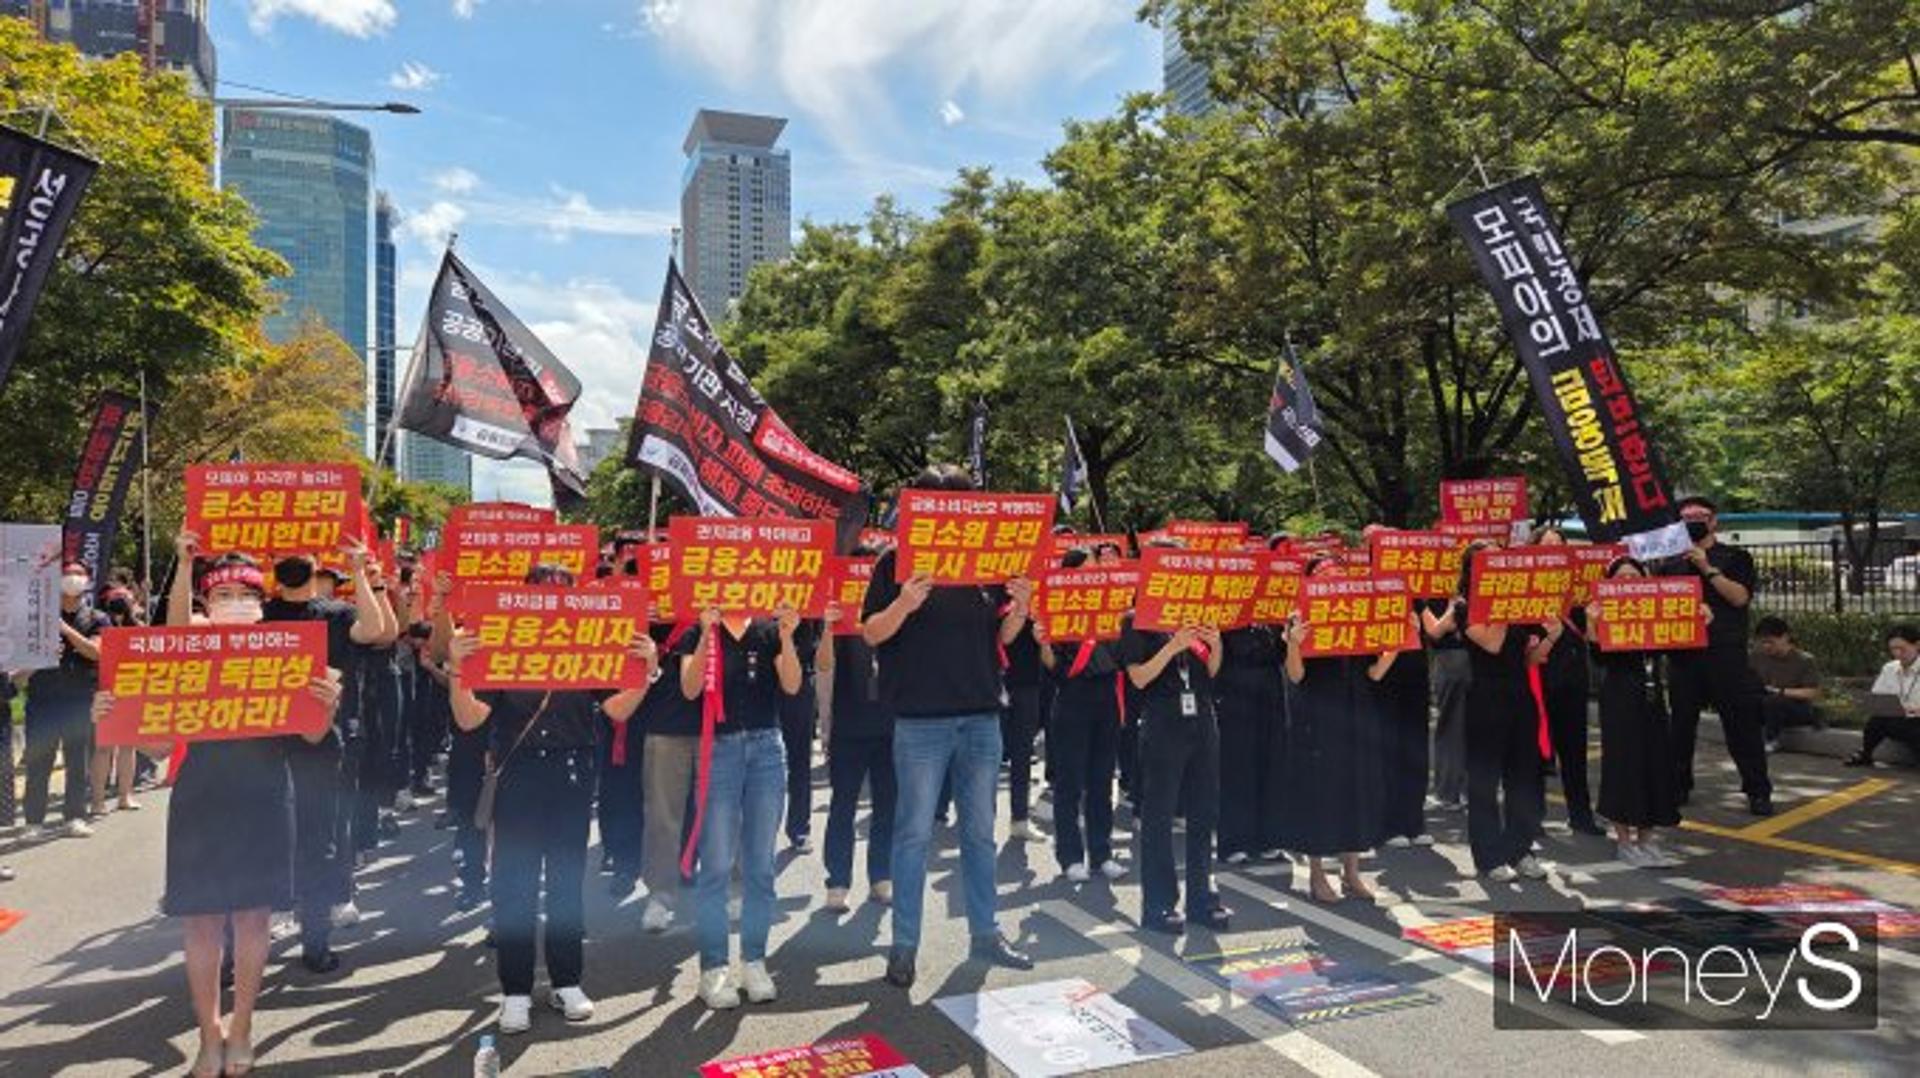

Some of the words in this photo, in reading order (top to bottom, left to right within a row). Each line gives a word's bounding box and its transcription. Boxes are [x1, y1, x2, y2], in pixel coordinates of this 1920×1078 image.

[1473, 204, 1571, 358] 모피아의
[205, 471, 249, 487] 모피아
[254, 471, 298, 485] 자리만
[302, 470, 343, 485] 늘리는
[201, 490, 286, 519] 금소원
[293, 490, 348, 518] 분리
[210, 521, 341, 549] 반대한다!
[909, 518, 988, 549] 금소원
[993, 520, 1042, 548] 분리
[456, 550, 532, 577] 금소원
[681, 546, 824, 579] 금융소비자
[914, 551, 966, 578] 결사
[974, 553, 1032, 577] 반대!
[1379, 549, 1437, 572] 금소원
[691, 581, 814, 612] 보호하자!
[1146, 572, 1208, 599] 금감원
[1479, 571, 1528, 596] 금감원
[1047, 588, 1101, 613] 금소원
[1310, 597, 1369, 625] 금소원
[1374, 594, 1407, 621] 분리
[1603, 598, 1655, 621] 금소원
[1662, 597, 1696, 619] 분리
[129, 633, 222, 653] 국제기준에
[228, 631, 301, 650] 부합하는
[479, 614, 636, 648] 금융소비자
[1313, 625, 1357, 651] 결사
[1364, 622, 1405, 649] 반대!
[1611, 623, 1646, 645] 결사
[1653, 621, 1696, 644] 반대!
[113, 659, 213, 698] 금감원
[218, 653, 315, 692] 독립성
[485, 652, 625, 682] 보호하자!
[137, 695, 291, 736] 보장하라!
